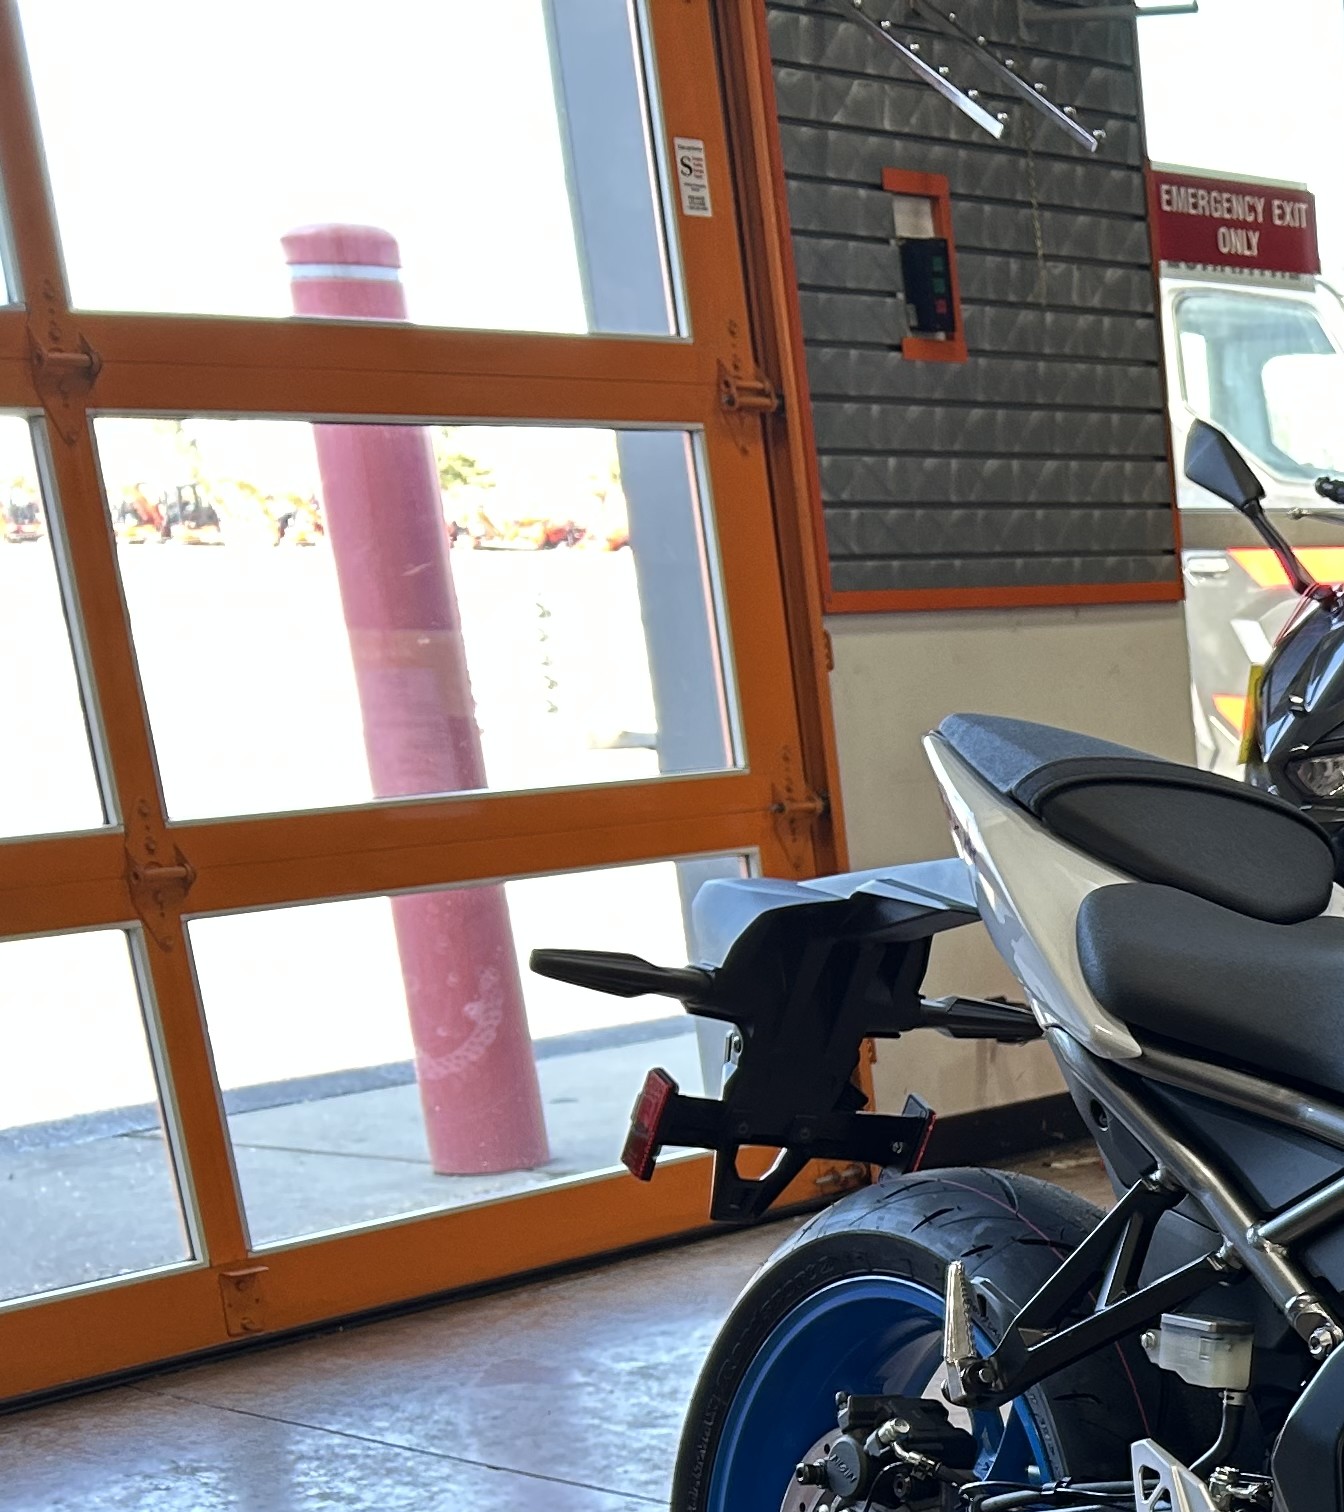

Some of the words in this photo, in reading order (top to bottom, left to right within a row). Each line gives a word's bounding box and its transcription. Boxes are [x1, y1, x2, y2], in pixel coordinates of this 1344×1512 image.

[1160, 184, 1265, 224] EMERGENCY
[1272, 200, 1308, 228] EXIT
[1217, 226, 1260, 257] ONLY
